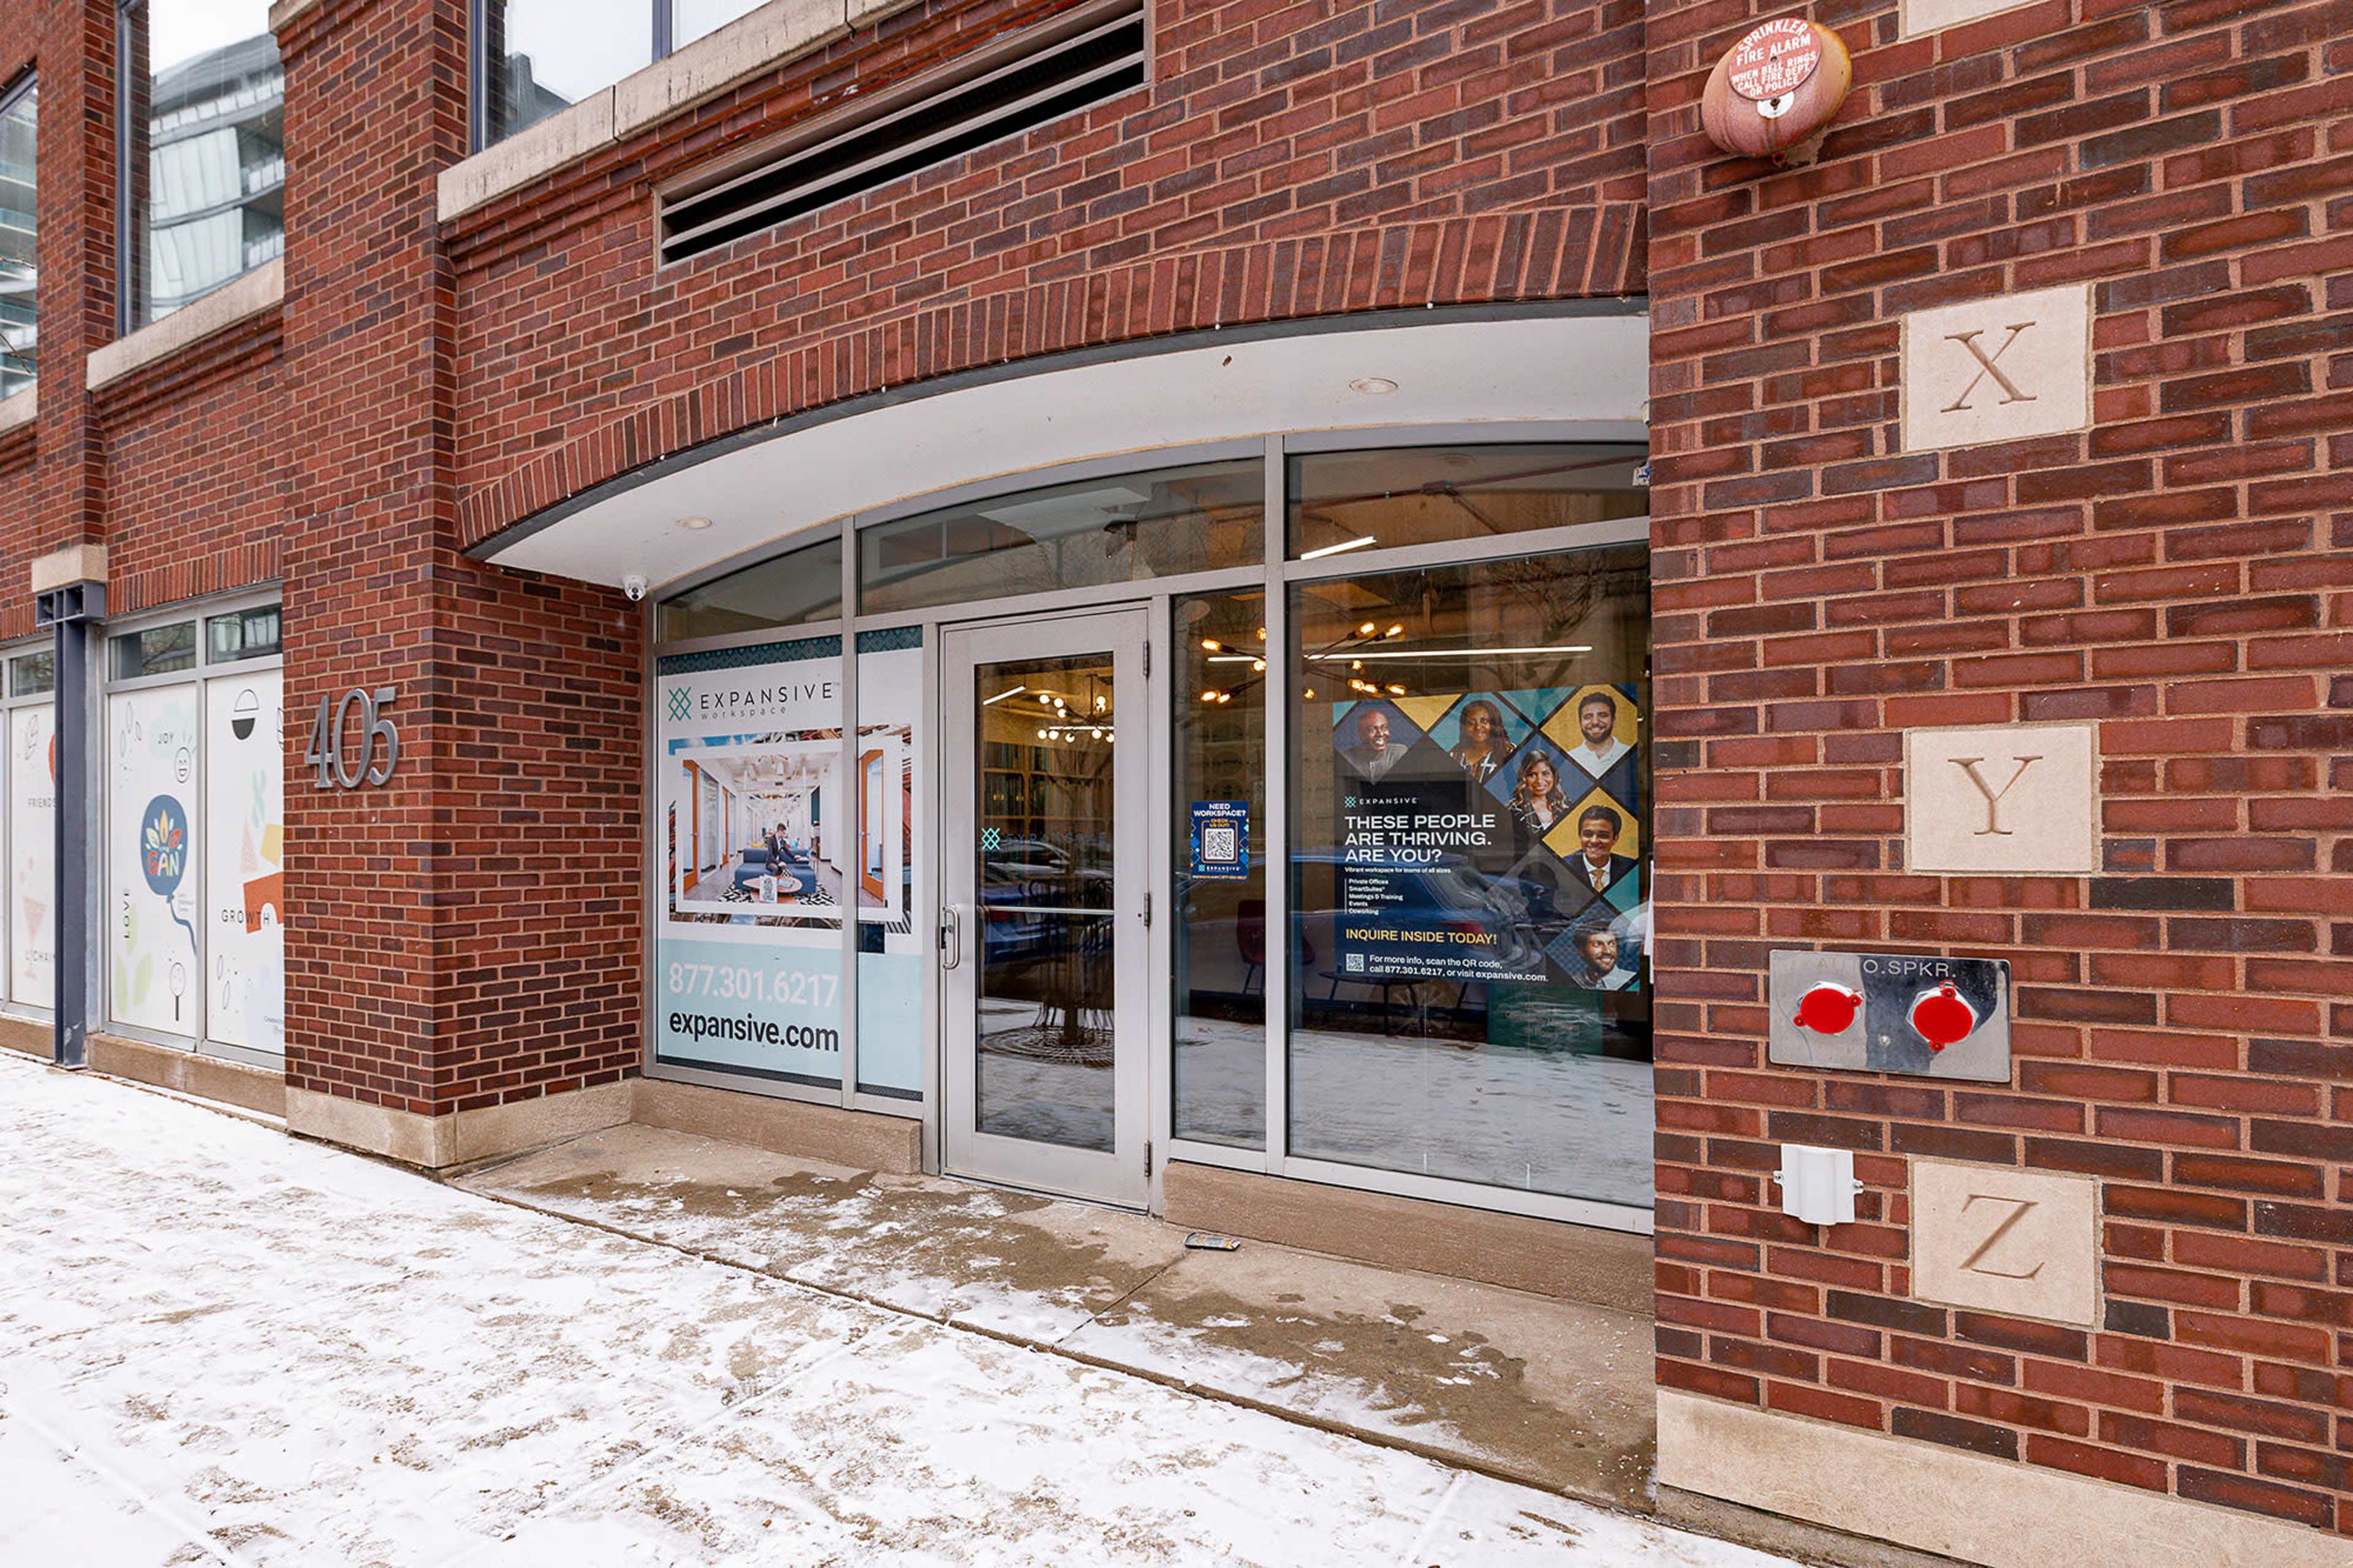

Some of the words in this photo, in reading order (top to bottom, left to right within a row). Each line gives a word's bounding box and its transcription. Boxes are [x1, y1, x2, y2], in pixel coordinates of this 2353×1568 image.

[1738, 19, 1808, 53] SPRINKLER
[1737, 47, 1765, 66] FIRE
[1769, 33, 1811, 56] ALARM
[1732, 69, 1759, 83] WHEN
[1761, 60, 1783, 74] BELL
[1787, 51, 1817, 67] RINGS
[1738, 78, 1760, 92] CALL
[1761, 72, 1783, 85] FIRE
[1749, 86, 1763, 97] OR
[1765, 76, 1799, 93] POLICE
[1940, 320, 2038, 414] X
[700, 706, 786, 720] workspace
[157, 732, 173, 744] JOY
[305, 686, 398, 789] 405
[1947, 755, 2044, 836] Y
[1344, 816, 1409, 829] THESE
[1414, 814, 1496, 828] PEOPLE
[1344, 832, 1384, 846] ARE
[1389, 831, 1492, 846] THRIVING.
[147, 850, 179, 877] GAN
[1345, 849, 1384, 862] ARE
[1389, 849, 1442, 862] YOU?
[221, 909, 270, 925] GROWTH
[1346, 929, 1398, 941] INQUIRE
[1401, 931, 1445, 942] INSIDE
[1447, 932, 1498, 945] TODAY!
[1406, 956, 1425, 966] info,
[1447, 958, 1461, 966] the
[1462, 958, 1477, 968] QR
[1478, 960, 1502, 969] code,
[1385, 965, 1446, 977] 877.301.6217,
[1457, 969, 1474, 978] visit
[1476, 971, 1549, 982] expansive.com.
[669, 962, 838, 1008] 877.301.6217
[669, 1012, 839, 1052] expansive.com
[1958, 1194, 2045, 1281] Z
